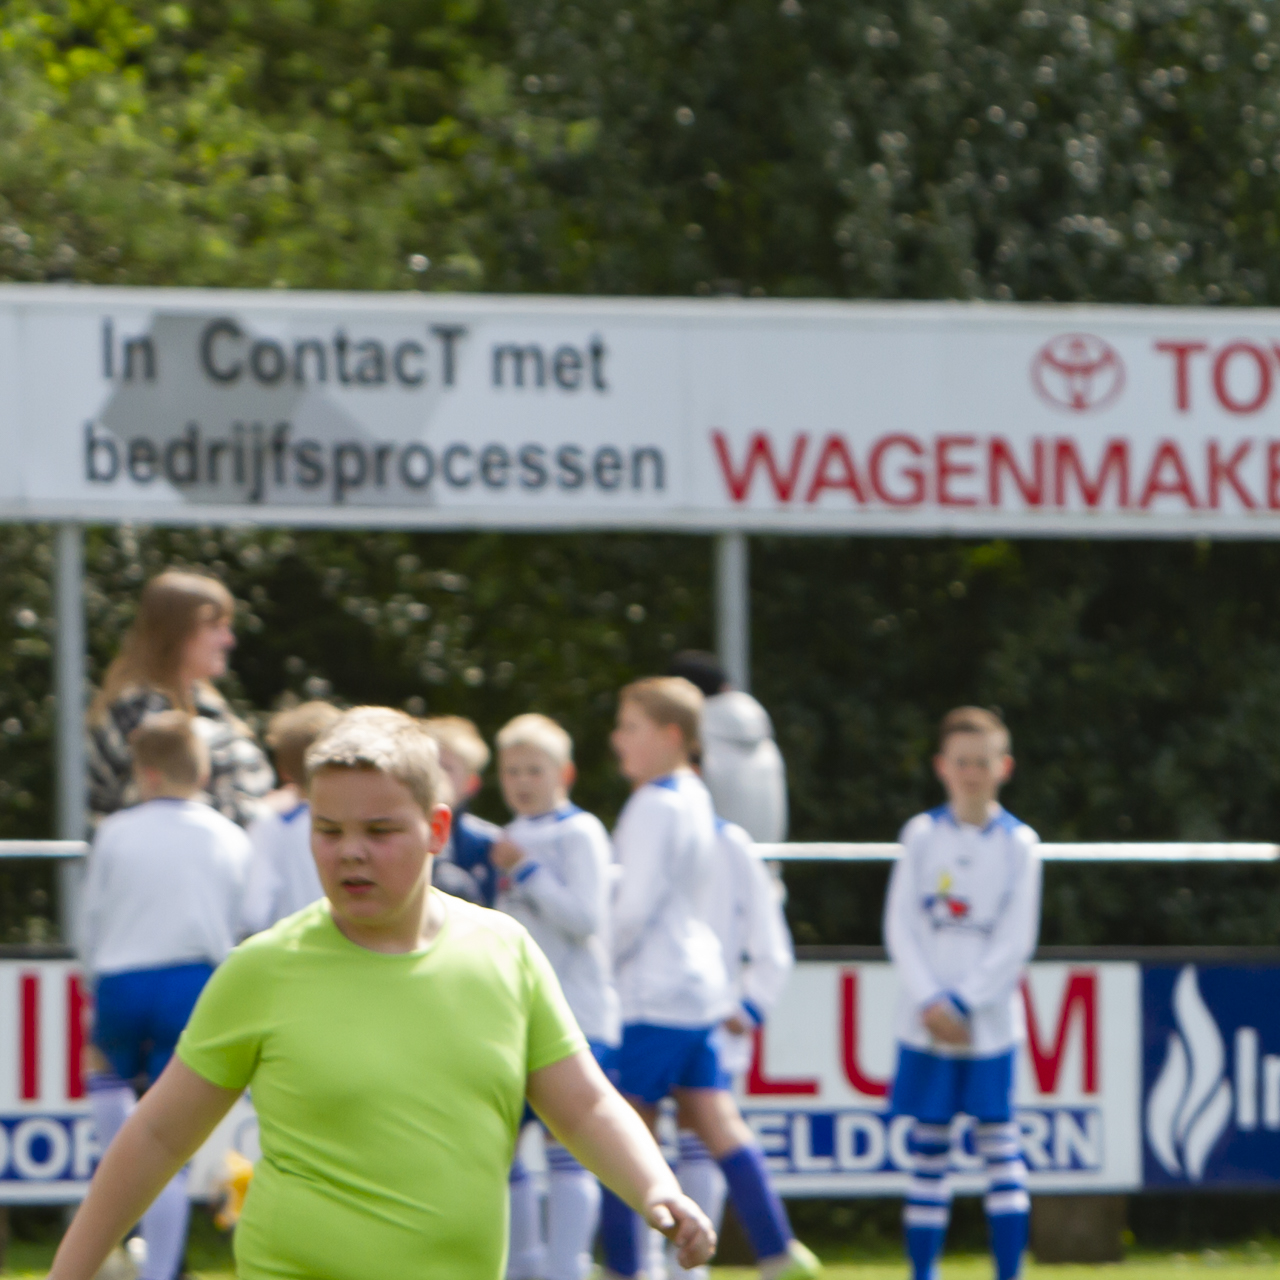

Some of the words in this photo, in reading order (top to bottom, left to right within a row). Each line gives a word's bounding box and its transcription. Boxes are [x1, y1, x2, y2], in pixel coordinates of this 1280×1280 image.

[101, 319, 156, 381] In
[199, 317, 468, 390] ContacT
[491, 334, 609, 392] met
[1154, 339, 1280, 416] TO
[82, 419, 667, 504] bedrijfsprocessen
